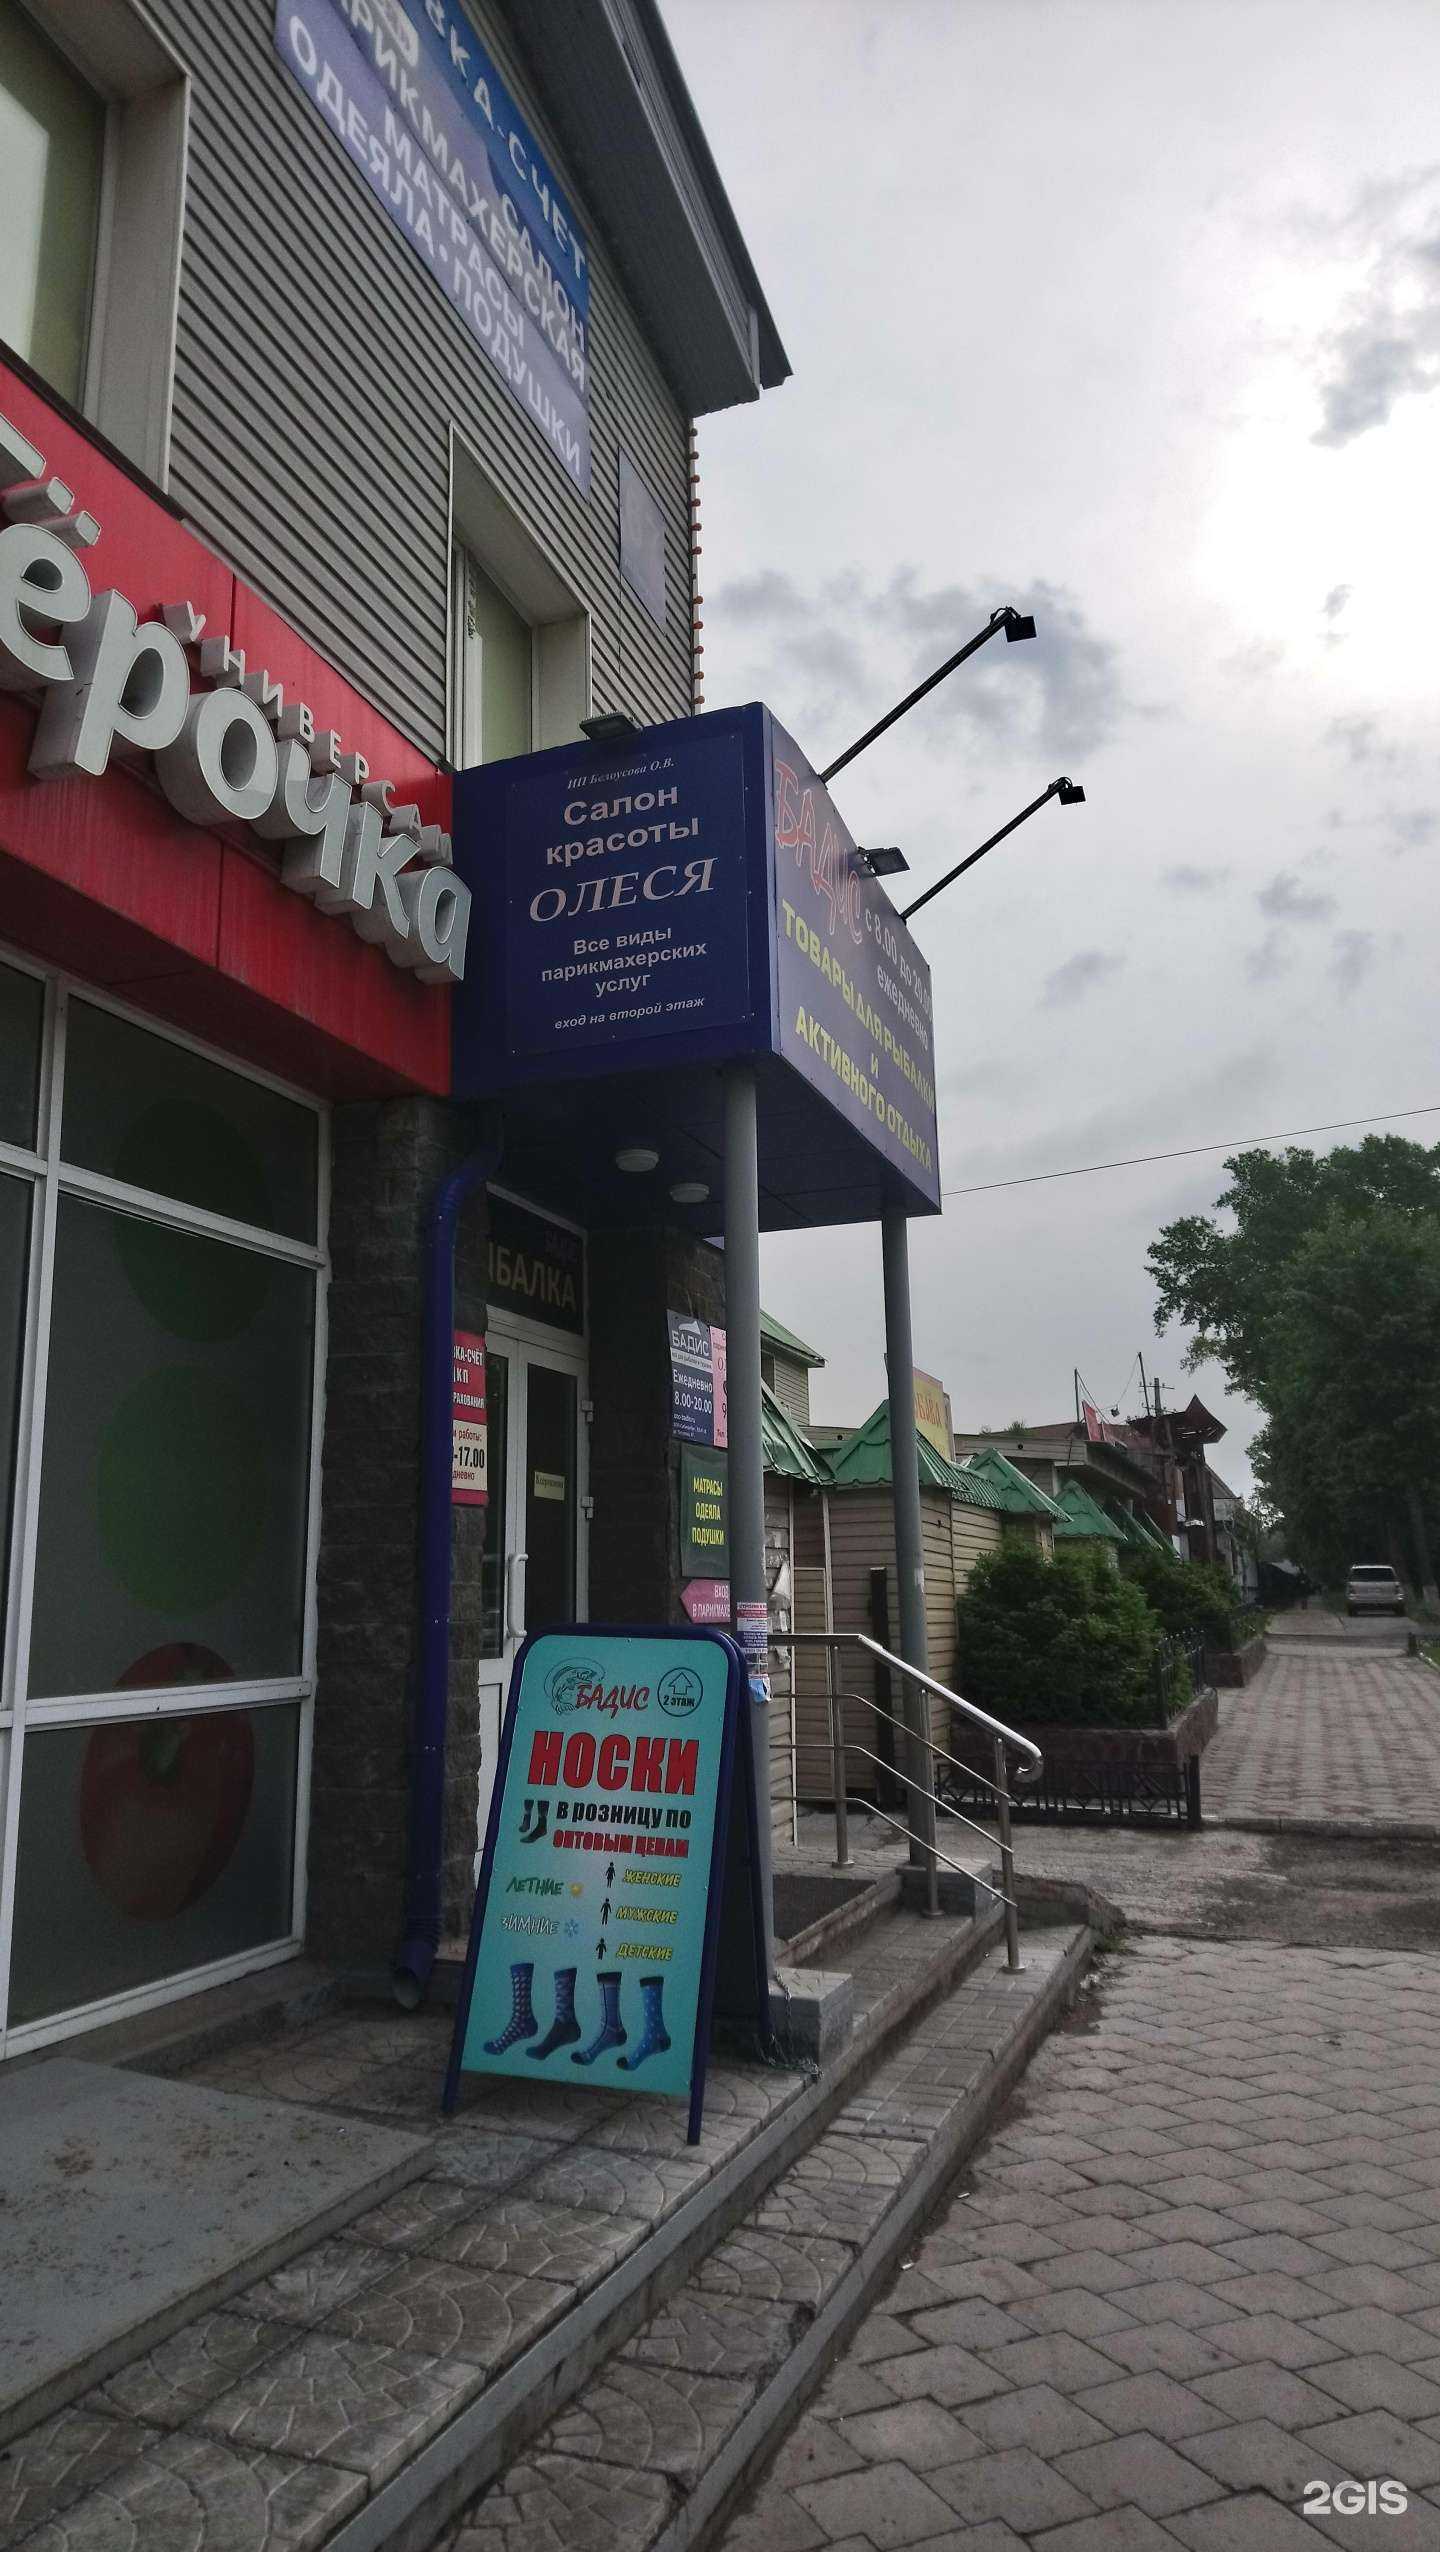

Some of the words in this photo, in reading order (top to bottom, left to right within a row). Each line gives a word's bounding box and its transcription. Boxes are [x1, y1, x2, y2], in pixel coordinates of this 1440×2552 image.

[385, 105, 524, 347] МАТРАСЫ
[502, 193, 585, 353] САЛОН
[454, 256, 581, 476] ПОДУШКИ
[0, 410, 473, 981] ёрочка
[564, 786, 678, 826] Салон
[546, 817, 699, 868] красоты
[775, 759, 864, 945] БАДИС
[529, 857, 718, 922] ОЛЕСЯ
[573, 938, 610, 956] Все
[616, 927, 672, 949] виды
[541, 943, 707, 983] парикмахерских
[595, 974, 651, 998] услуг
[554, 1014, 587, 1030] вход
[589, 1012, 605, 1025] на
[608, 1002, 662, 1022] второй
[665, 996, 705, 1012] этаж
[781, 898, 855, 1011] ТОВАРЫ
[855, 992, 883, 1047] ДЛЯ
[883, 1024, 936, 1116] РЫБАЛКИ
[877, 964, 929, 1051] ежедневно
[795, 1005, 886, 1123] АКТИВНОГО
[886, 1106, 932, 1173] ОТДЫХА
[671, 1330, 710, 1357] БАДИС
[673, 1369, 713, 1393] Ежедневно
[674, 1391, 713, 1414] 8.00-20.00
[453, 1446, 485, 1469] -17.00
[693, 1476, 723, 1497] МАТРАСЫ
[695, 1502, 721, 1521] ОДЕЯЛА
[691, 1527, 725, 1547] ПОДУШКИ
[576, 1683, 650, 1719] БАДИС
[663, 1695, 669, 1706] 2
[669, 1696, 695, 1707] этаж
[528, 1730, 700, 1796] НОСКИ
[572, 1802, 662, 1829] розницу
[666, 1809, 692, 1829] по
[505, 1876, 564, 1897] ЛЕТНИЕ
[624, 1869, 682, 1888] ЖЕНСКИЕ
[501, 1912, 560, 1936] ЗИМНИЕ
[615, 1906, 678, 1925] МУЖСКИЕ
[616, 1942, 673, 1962] ДЕТСКИЕ
